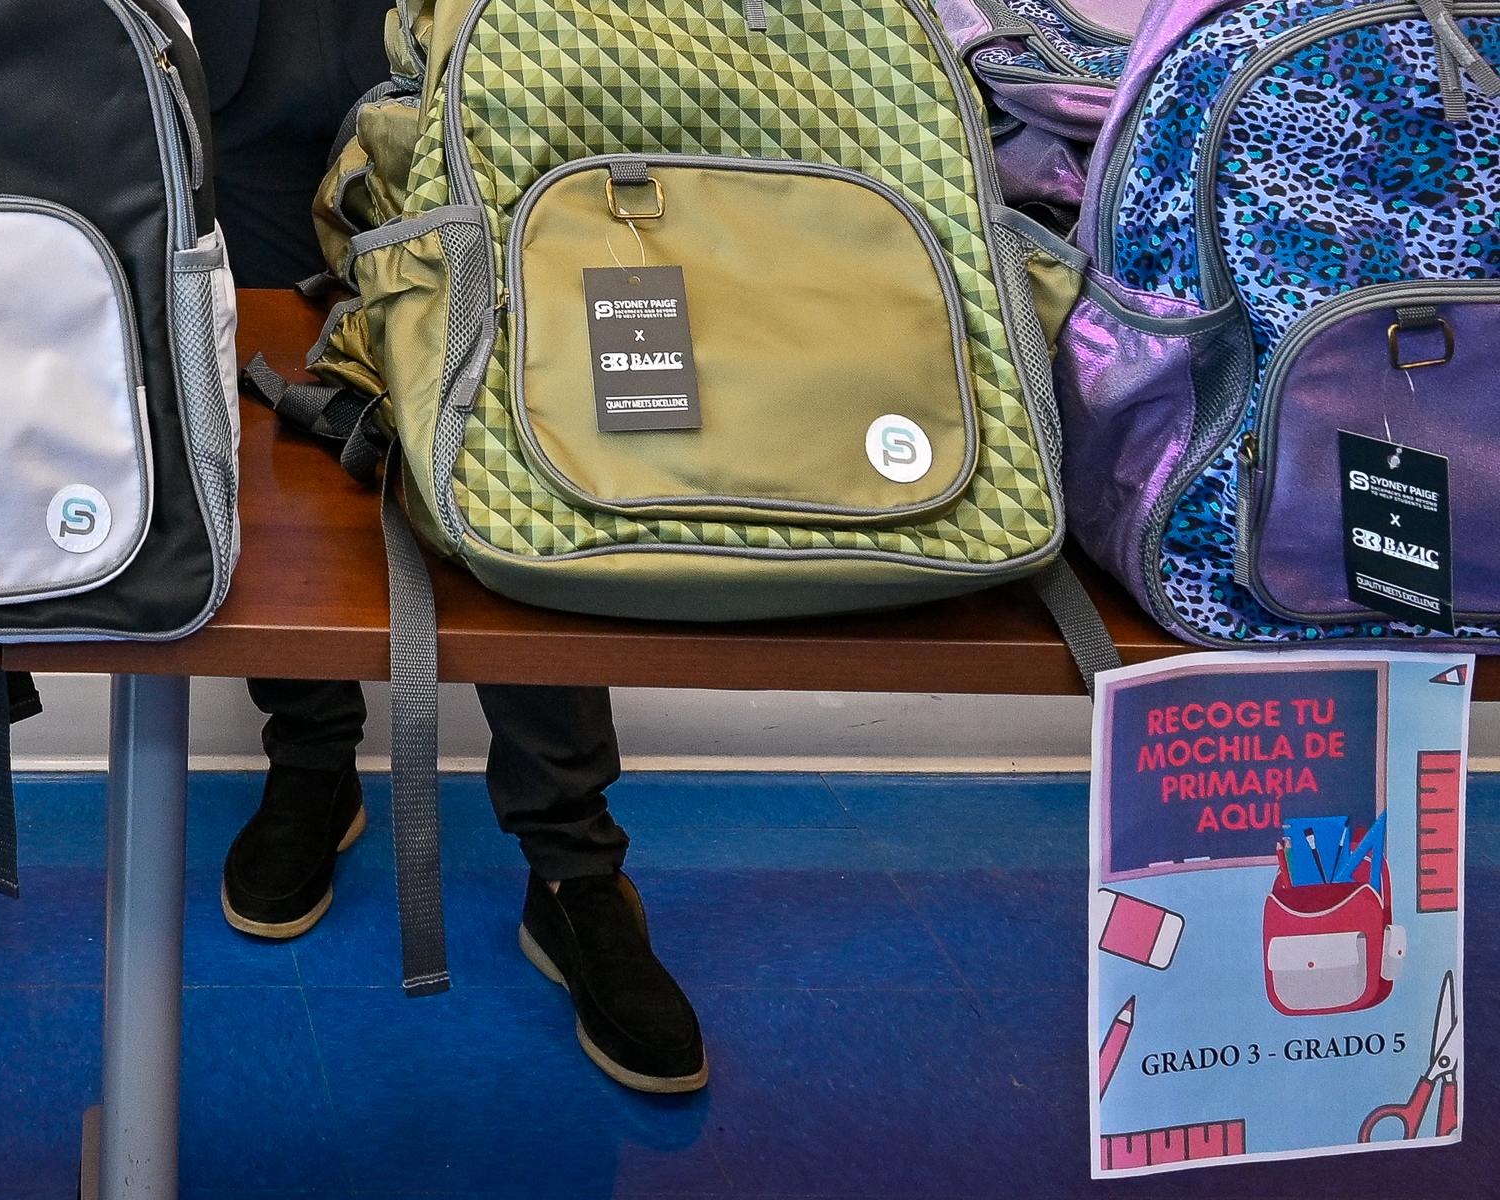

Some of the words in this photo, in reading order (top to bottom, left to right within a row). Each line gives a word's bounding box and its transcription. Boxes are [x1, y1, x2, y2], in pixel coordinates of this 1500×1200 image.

[614, 300, 649, 309] SYDNEY
[650, 299, 678, 308] PAIGE
[630, 352, 683, 366] BAZIC
[1370, 474, 1408, 494] SYDNEY
[1409, 485, 1439, 502] PAIGE
[1383, 536, 1440, 565] BAZIC
[1146, 699, 1283, 736] RECOGE
[1288, 698, 1335, 727] TU
[1136, 734, 1295, 773] MOCHILA
[1304, 730, 1346, 759] DE
[1161, 765, 1319, 802] PRIMARIA
[1141, 1042, 1240, 1077] GRADO
[1247, 1042, 1262, 1066] 3
[1283, 1034, 1386, 1062] GRADO
[1392, 1032, 1407, 1055] 5
